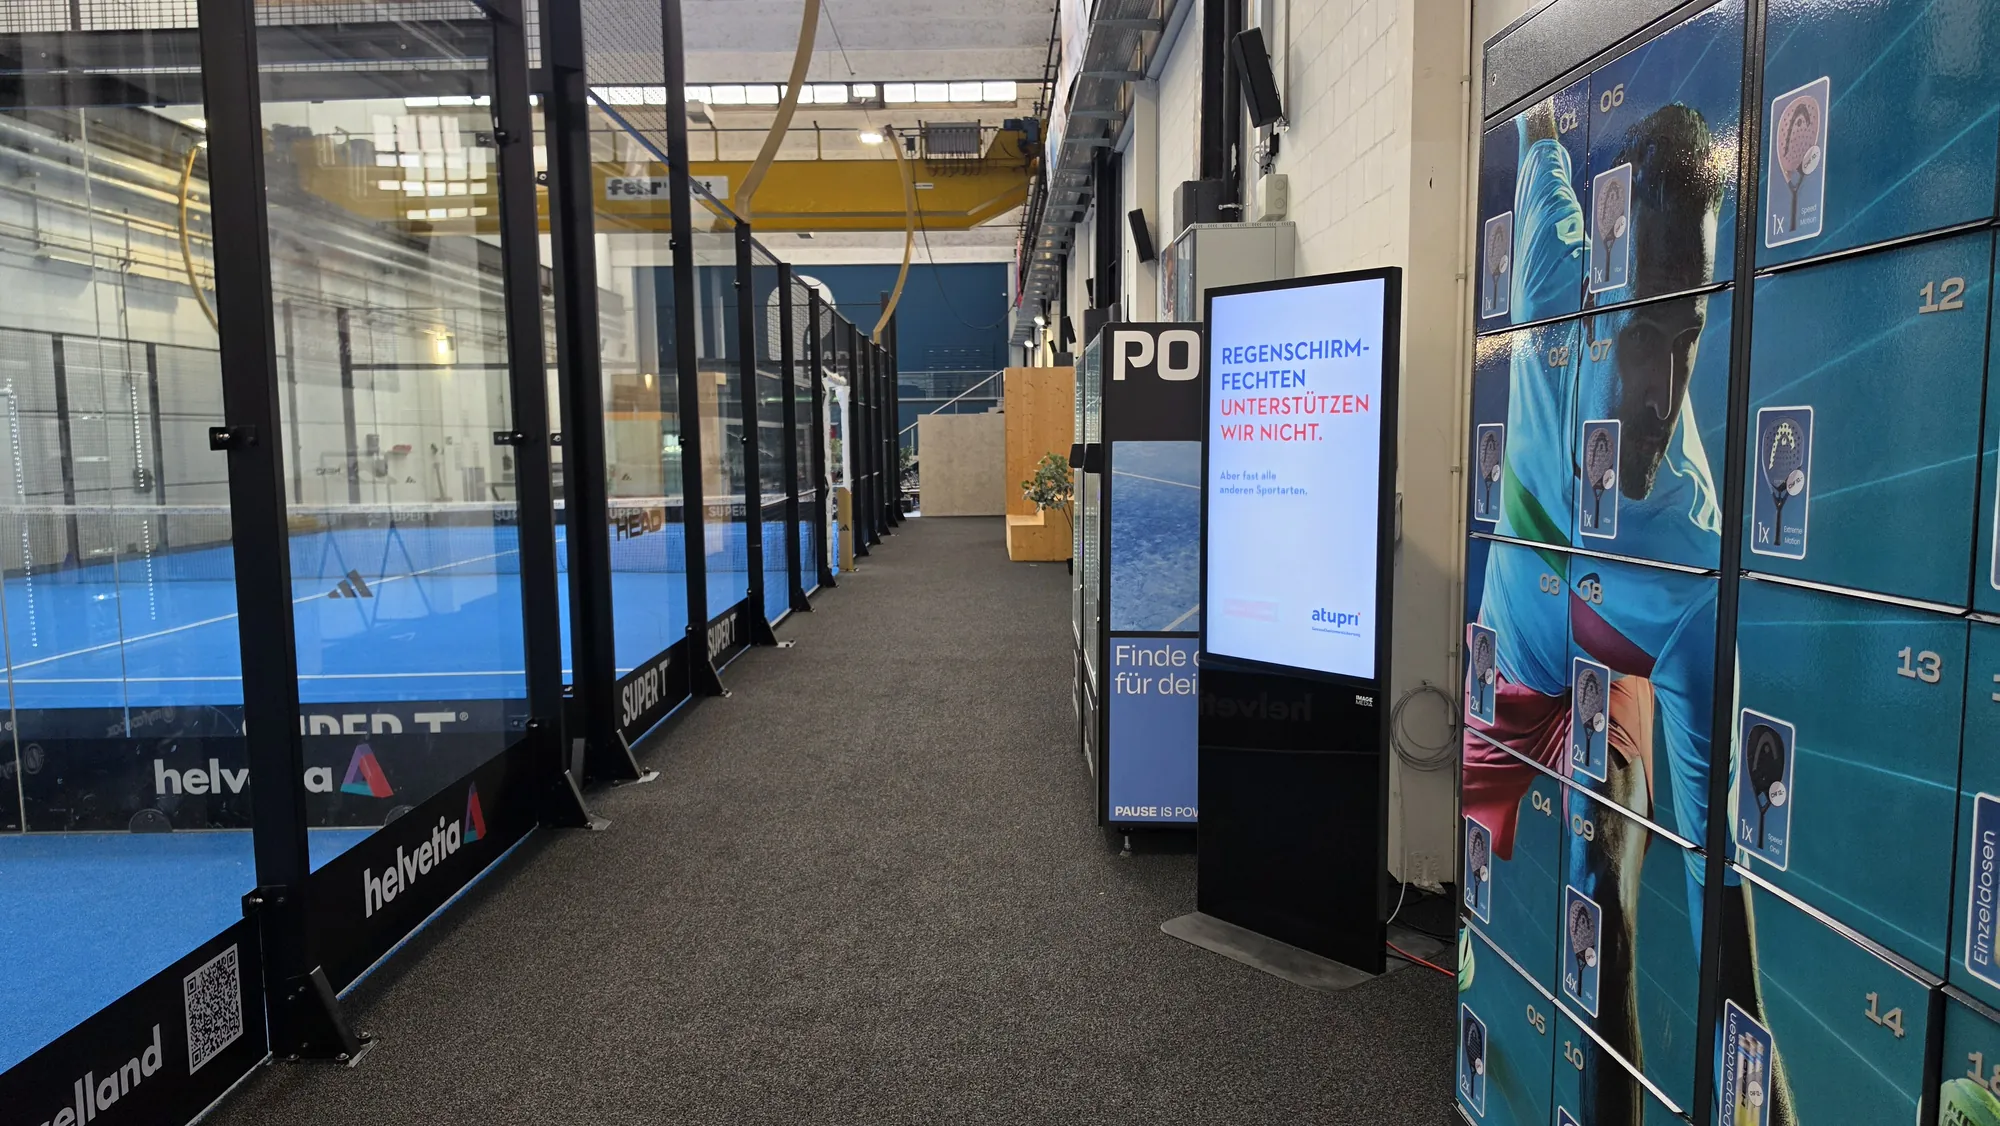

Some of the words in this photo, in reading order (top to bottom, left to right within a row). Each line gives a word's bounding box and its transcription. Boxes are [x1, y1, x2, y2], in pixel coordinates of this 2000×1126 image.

[1600, 84, 1625, 113] 06
[1559, 109, 1579, 134] 01
[1772, 214, 1784, 236] 1x
[1593, 267, 1603, 285] 1x
[1918, 277, 1965, 314] 12
[1222, 338, 1370, 365] REGENSCHIRM-
[1549, 346, 1569, 368] 02
[1589, 339, 1613, 362] 07
[1221, 369, 1306, 391] FECHTEN
[1221, 391, 1369, 416] UNTERSTÜTZEN
[1220, 424, 1254, 441] WIR
[1260, 423, 1323, 441] NICHT.
[1220, 470, 1240, 481] Aber
[1242, 470, 1259, 481] fast
[1261, 470, 1277, 481] alle
[1219, 485, 1254, 495] anderen
[616, 509, 662, 541] HEAD
[1583, 510, 1592, 527] 1x
[1783, 525, 1803, 535] Extreme
[1757, 521, 1770, 544] 1x
[1784, 537, 1801, 545] Motion
[1539, 573, 1561, 595] 03
[1579, 580, 1604, 604] 08
[1311, 607, 1361, 628] atupri
[707, 618, 730, 661] SUPER
[730, 613, 737, 642] T
[1116, 644, 1187, 667] Finde
[1897, 646, 1941, 683] 13
[1115, 672, 1152, 694] für
[622, 667, 659, 727] SUPER
[1573, 745, 1585, 764] 2x
[154, 758, 333, 795] helva
[1115, 805, 1157, 817] PAUSE
[1160, 806, 1172, 817] IS
[1531, 790, 1552, 817] 04
[1572, 814, 1595, 841] 09
[1741, 818, 1752, 844] 1x
[363, 815, 461, 918] helvetia
[1973, 829, 1996, 965] Einzeldosen
[1565, 972, 1578, 991] 4x
[1526, 1004, 1546, 1035] 05
[1865, 991, 1905, 1038] 14
[1563, 1040, 1584, 1071] 10
[1722, 1012, 1737, 1126] Doppeldosen
[1740, 1058, 1748, 1109] HEAD
